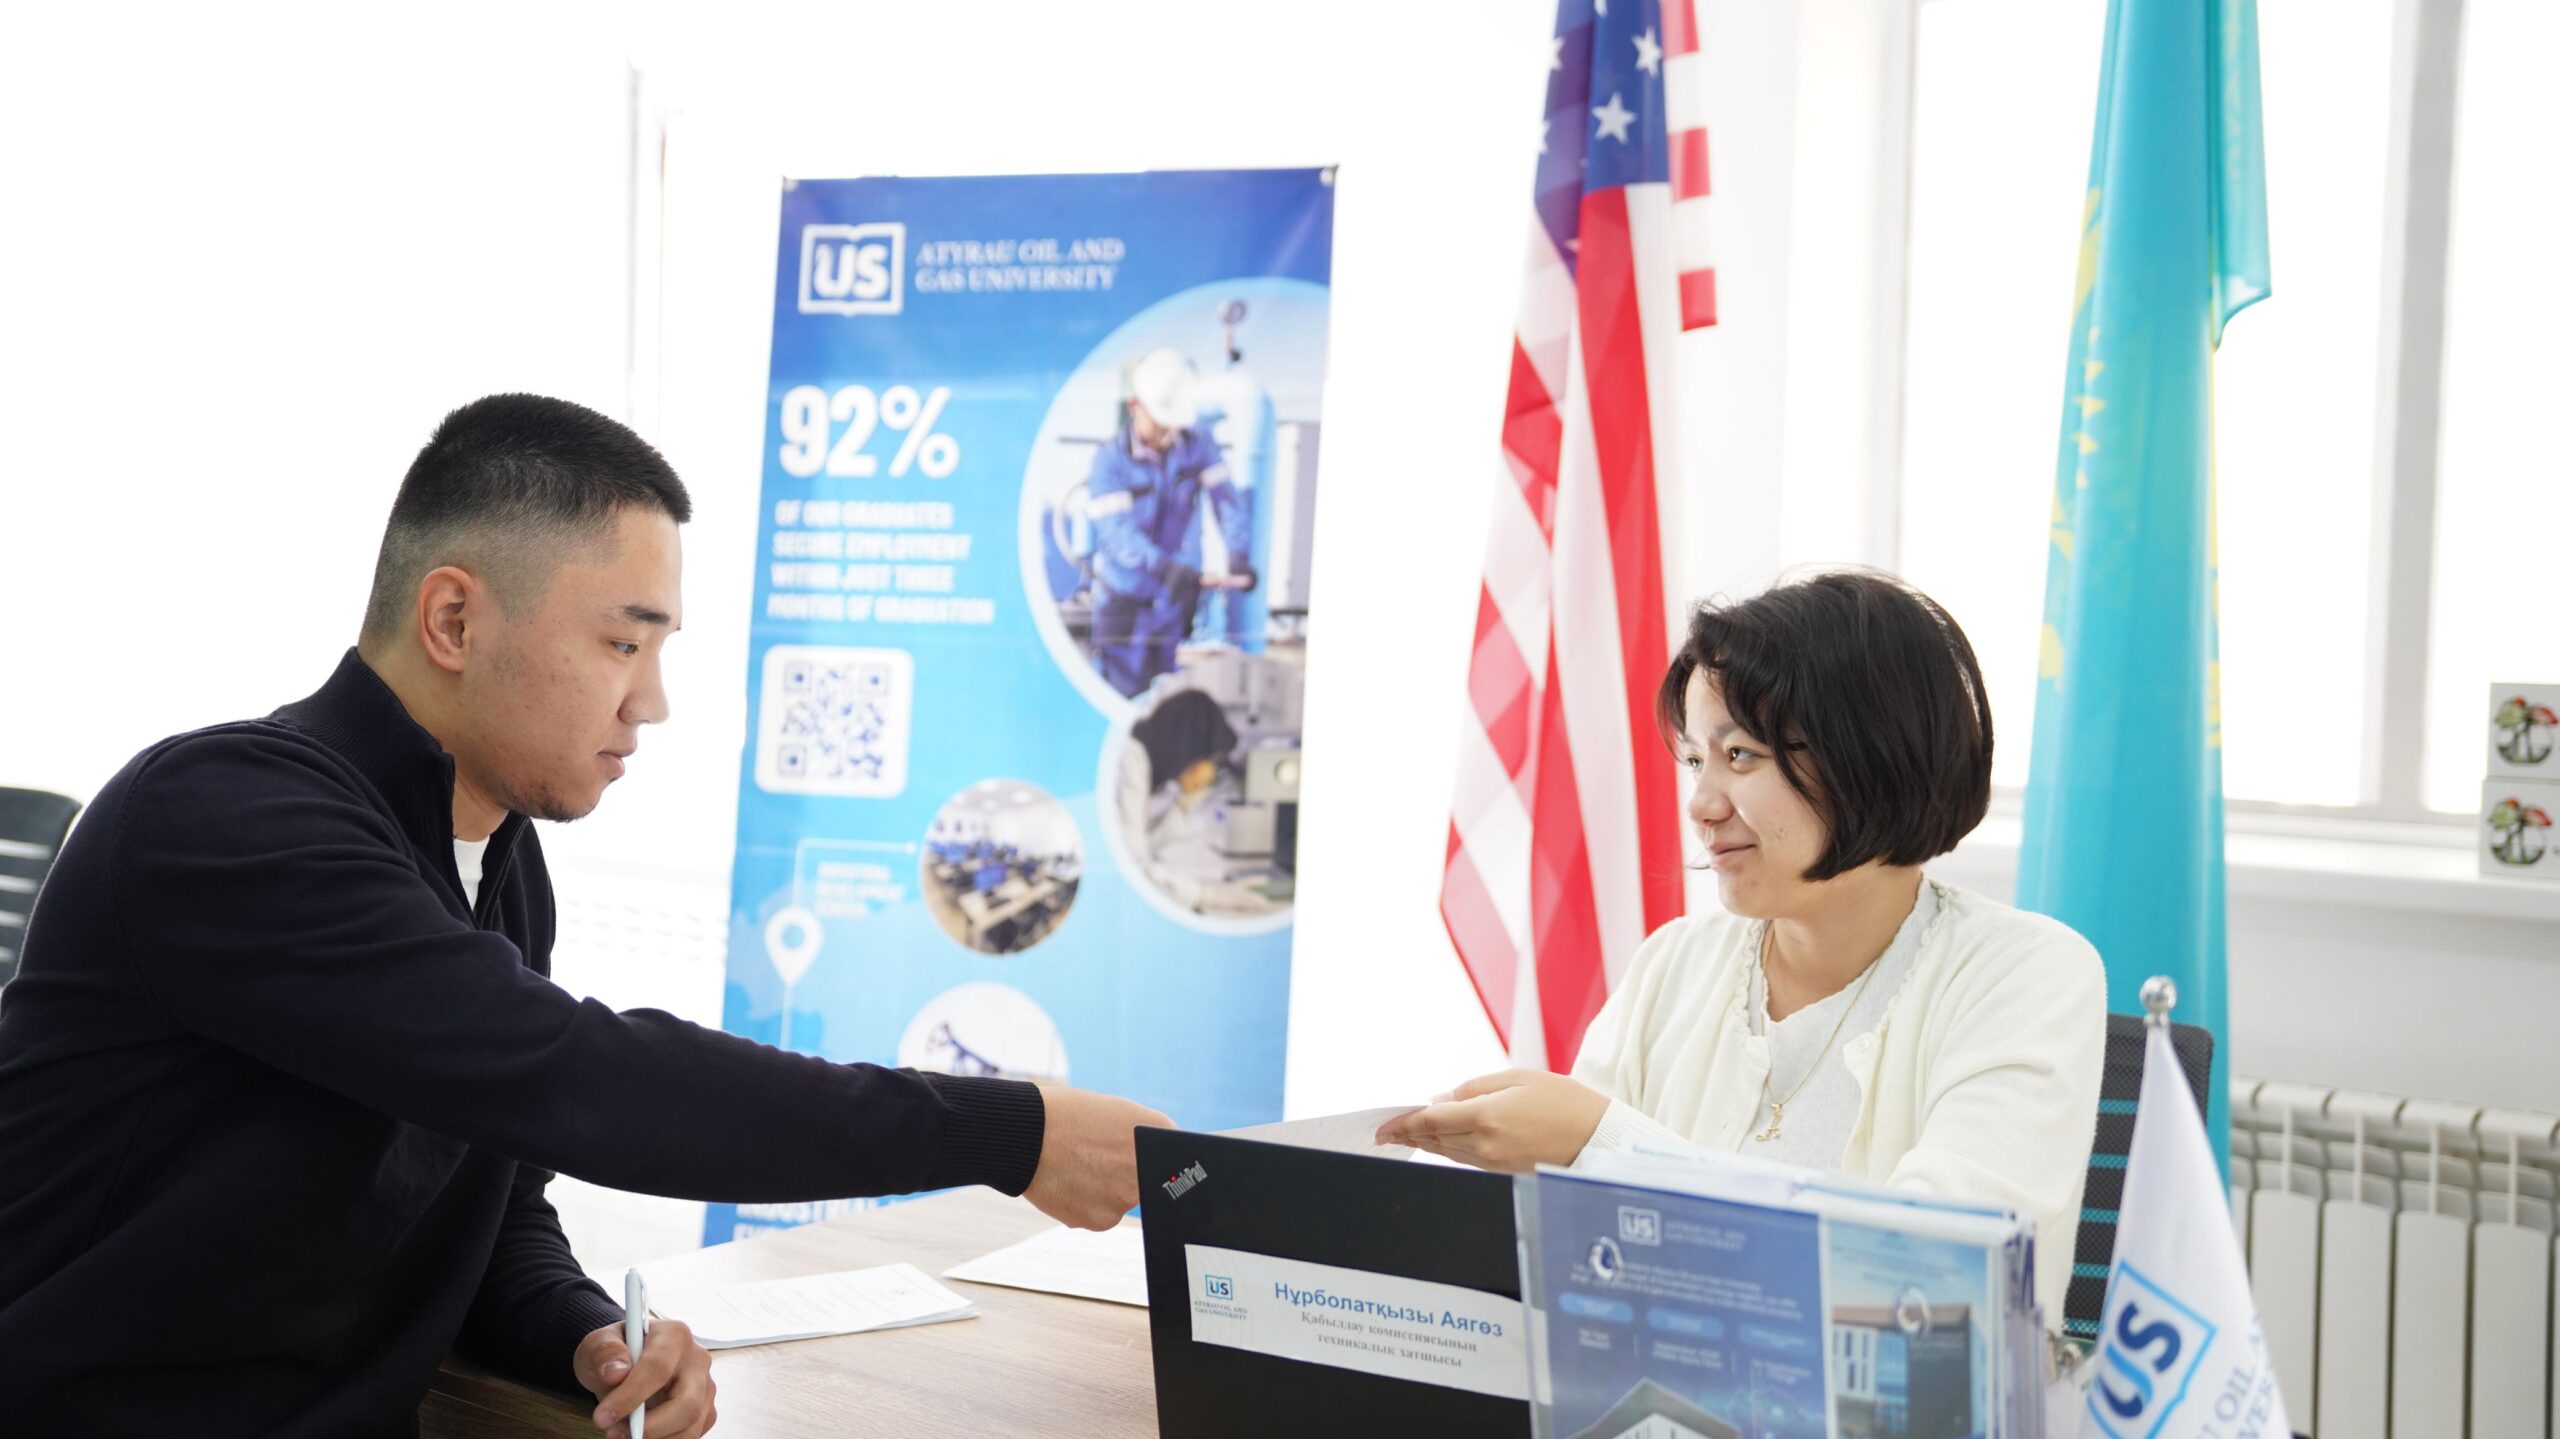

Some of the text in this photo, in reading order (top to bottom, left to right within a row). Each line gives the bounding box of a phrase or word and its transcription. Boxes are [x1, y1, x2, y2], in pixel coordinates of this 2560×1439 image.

[812, 243, 890, 300] US
[917, 238, 1125, 266] ATYRAU OIL AND
[915, 265, 1118, 293] GAS UNIVERSITY
[779, 384, 960, 478] 92%
[1162, 1160, 1207, 1200] ThinkPad
[1209, 1280, 1229, 1296] US
[1275, 1282, 1503, 1337] Нұрболатқызы Аягөз
[2097, 1301, 2182, 1419] US
